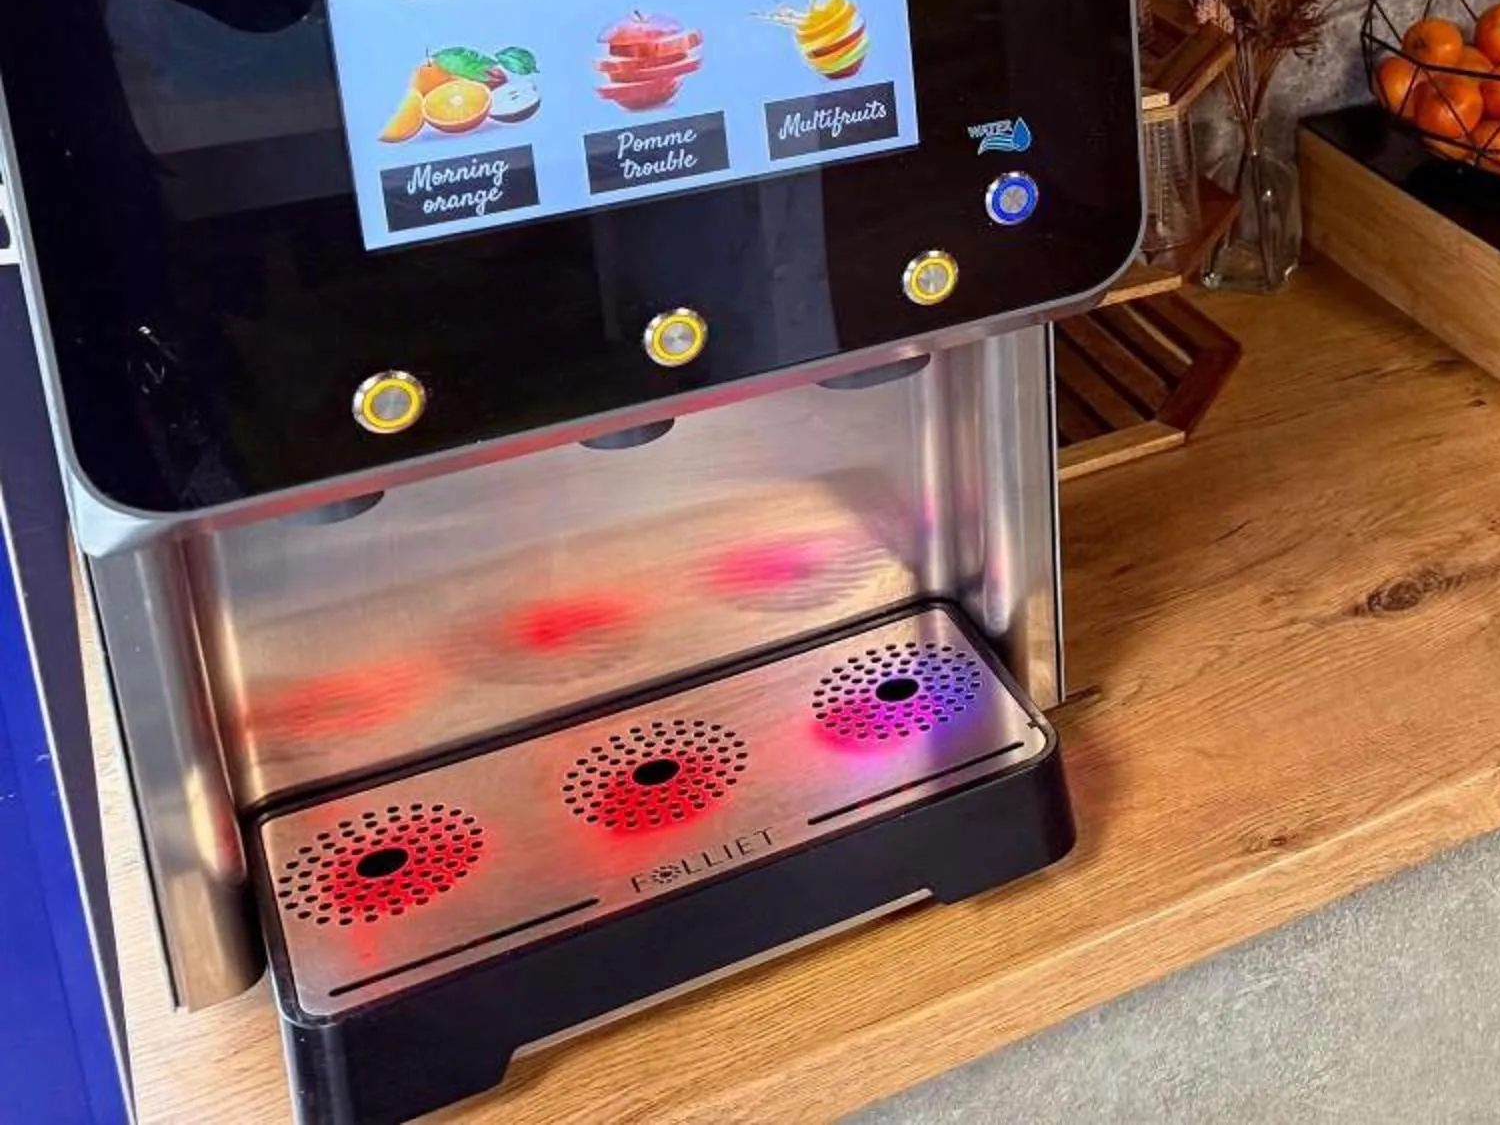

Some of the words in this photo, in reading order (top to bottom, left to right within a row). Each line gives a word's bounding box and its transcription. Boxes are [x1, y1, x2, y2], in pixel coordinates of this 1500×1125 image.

[778, 100, 887, 140] Multifruits
[617, 129, 698, 160] Pomme
[407, 159, 510, 195] Morning
[620, 148, 699, 179] trouble
[423, 186, 504, 216] orange
